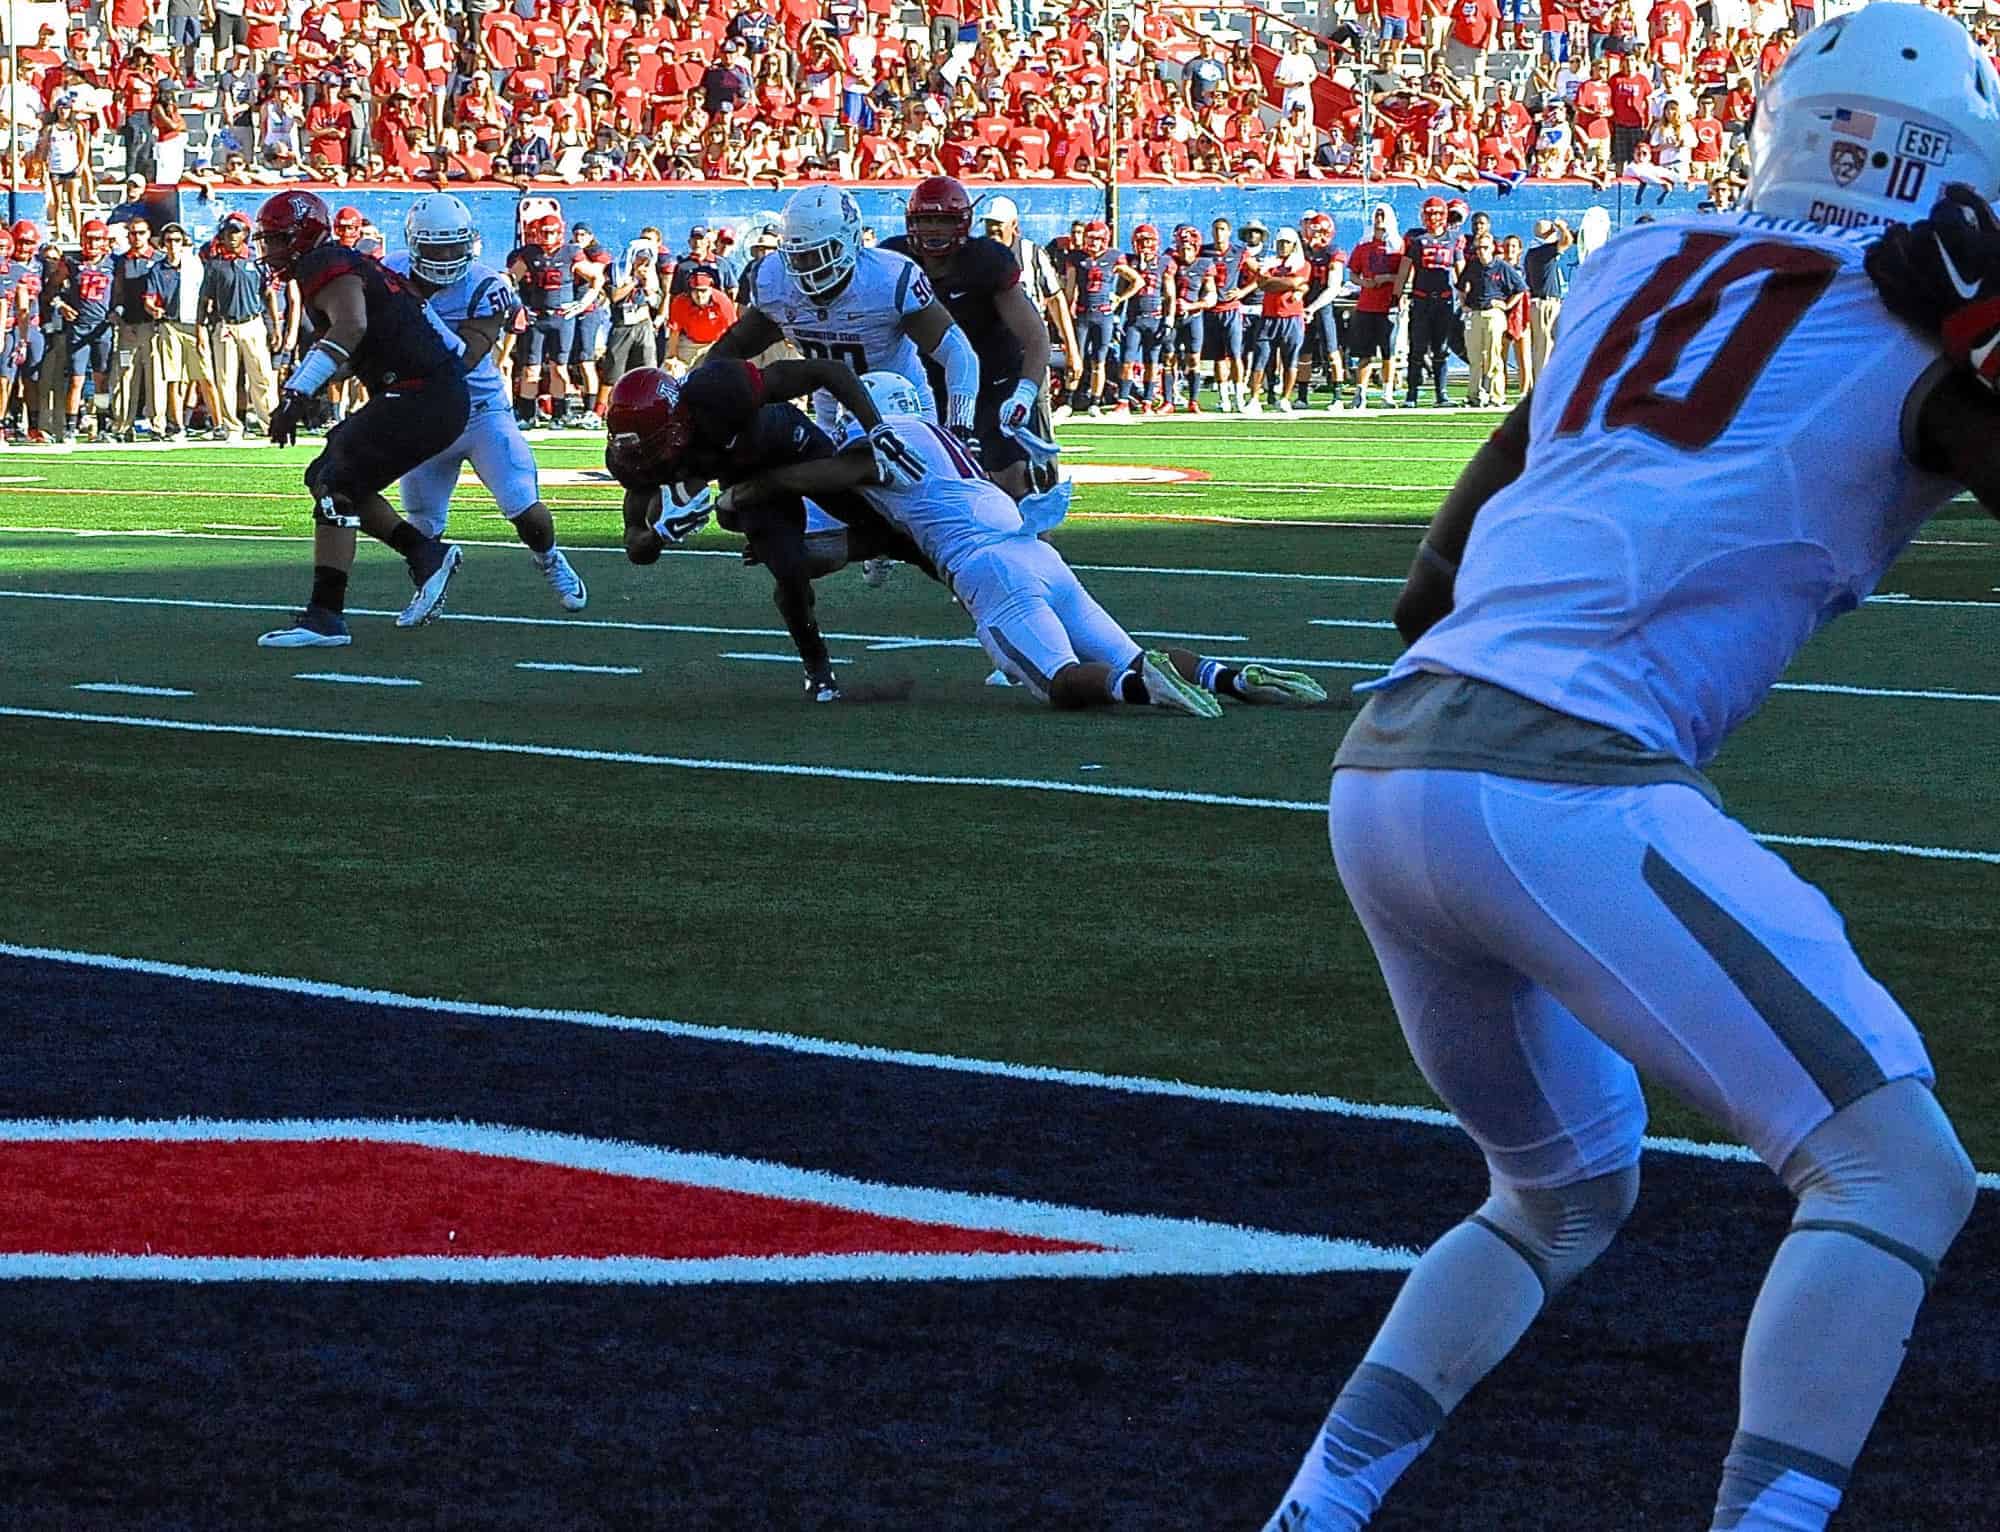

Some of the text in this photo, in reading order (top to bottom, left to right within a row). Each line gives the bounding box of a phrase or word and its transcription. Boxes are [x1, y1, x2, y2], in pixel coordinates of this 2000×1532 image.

[1904, 128, 1945, 159] ESF
[1885, 155, 1926, 204] 10
[1553, 231, 1846, 452] 10
